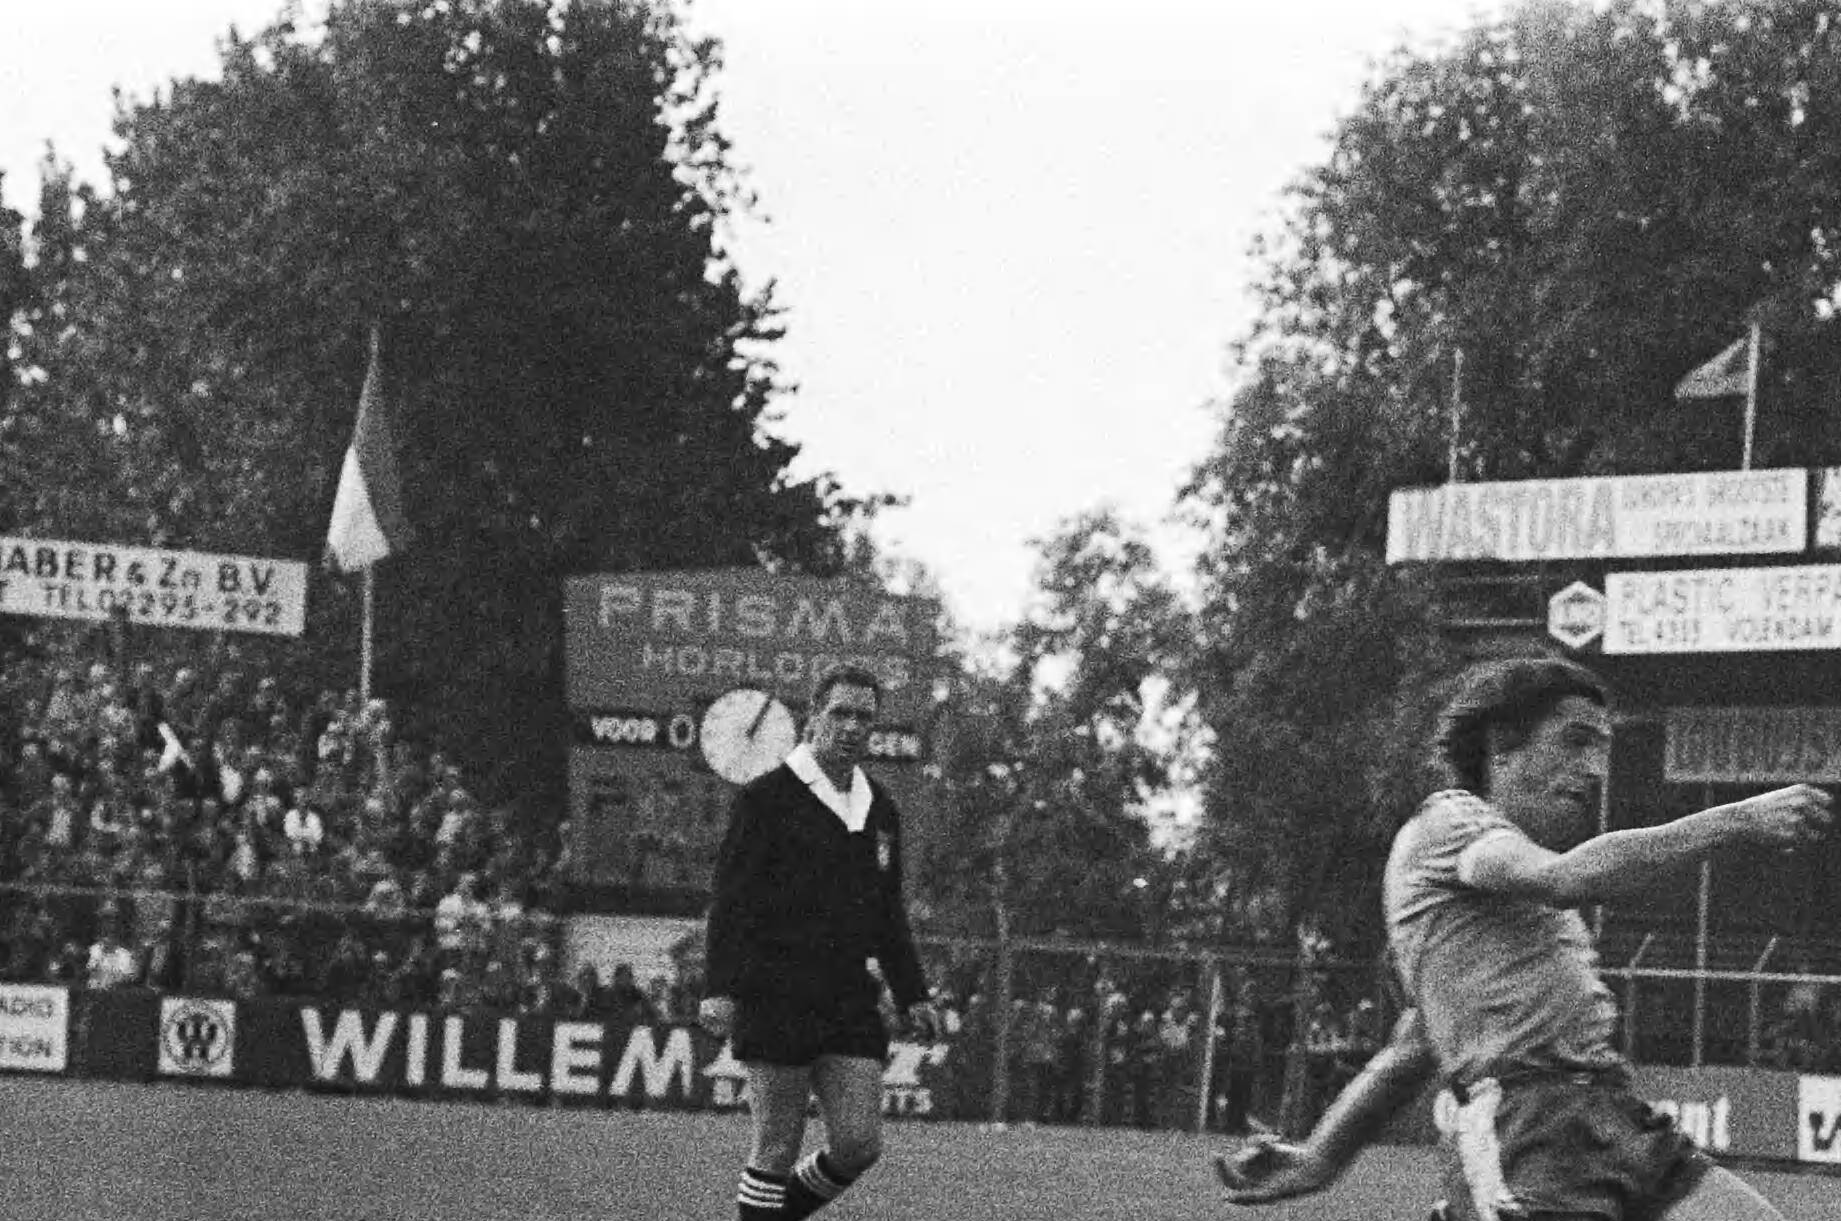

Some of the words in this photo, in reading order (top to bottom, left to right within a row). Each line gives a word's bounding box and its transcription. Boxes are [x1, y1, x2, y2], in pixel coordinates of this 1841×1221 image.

[0, 544, 117, 582] ABER
[598, 584, 908, 645] PRISMA
[1621, 577, 1734, 615] PLASTIC
[300, 1005, 694, 1099] WILLEM
